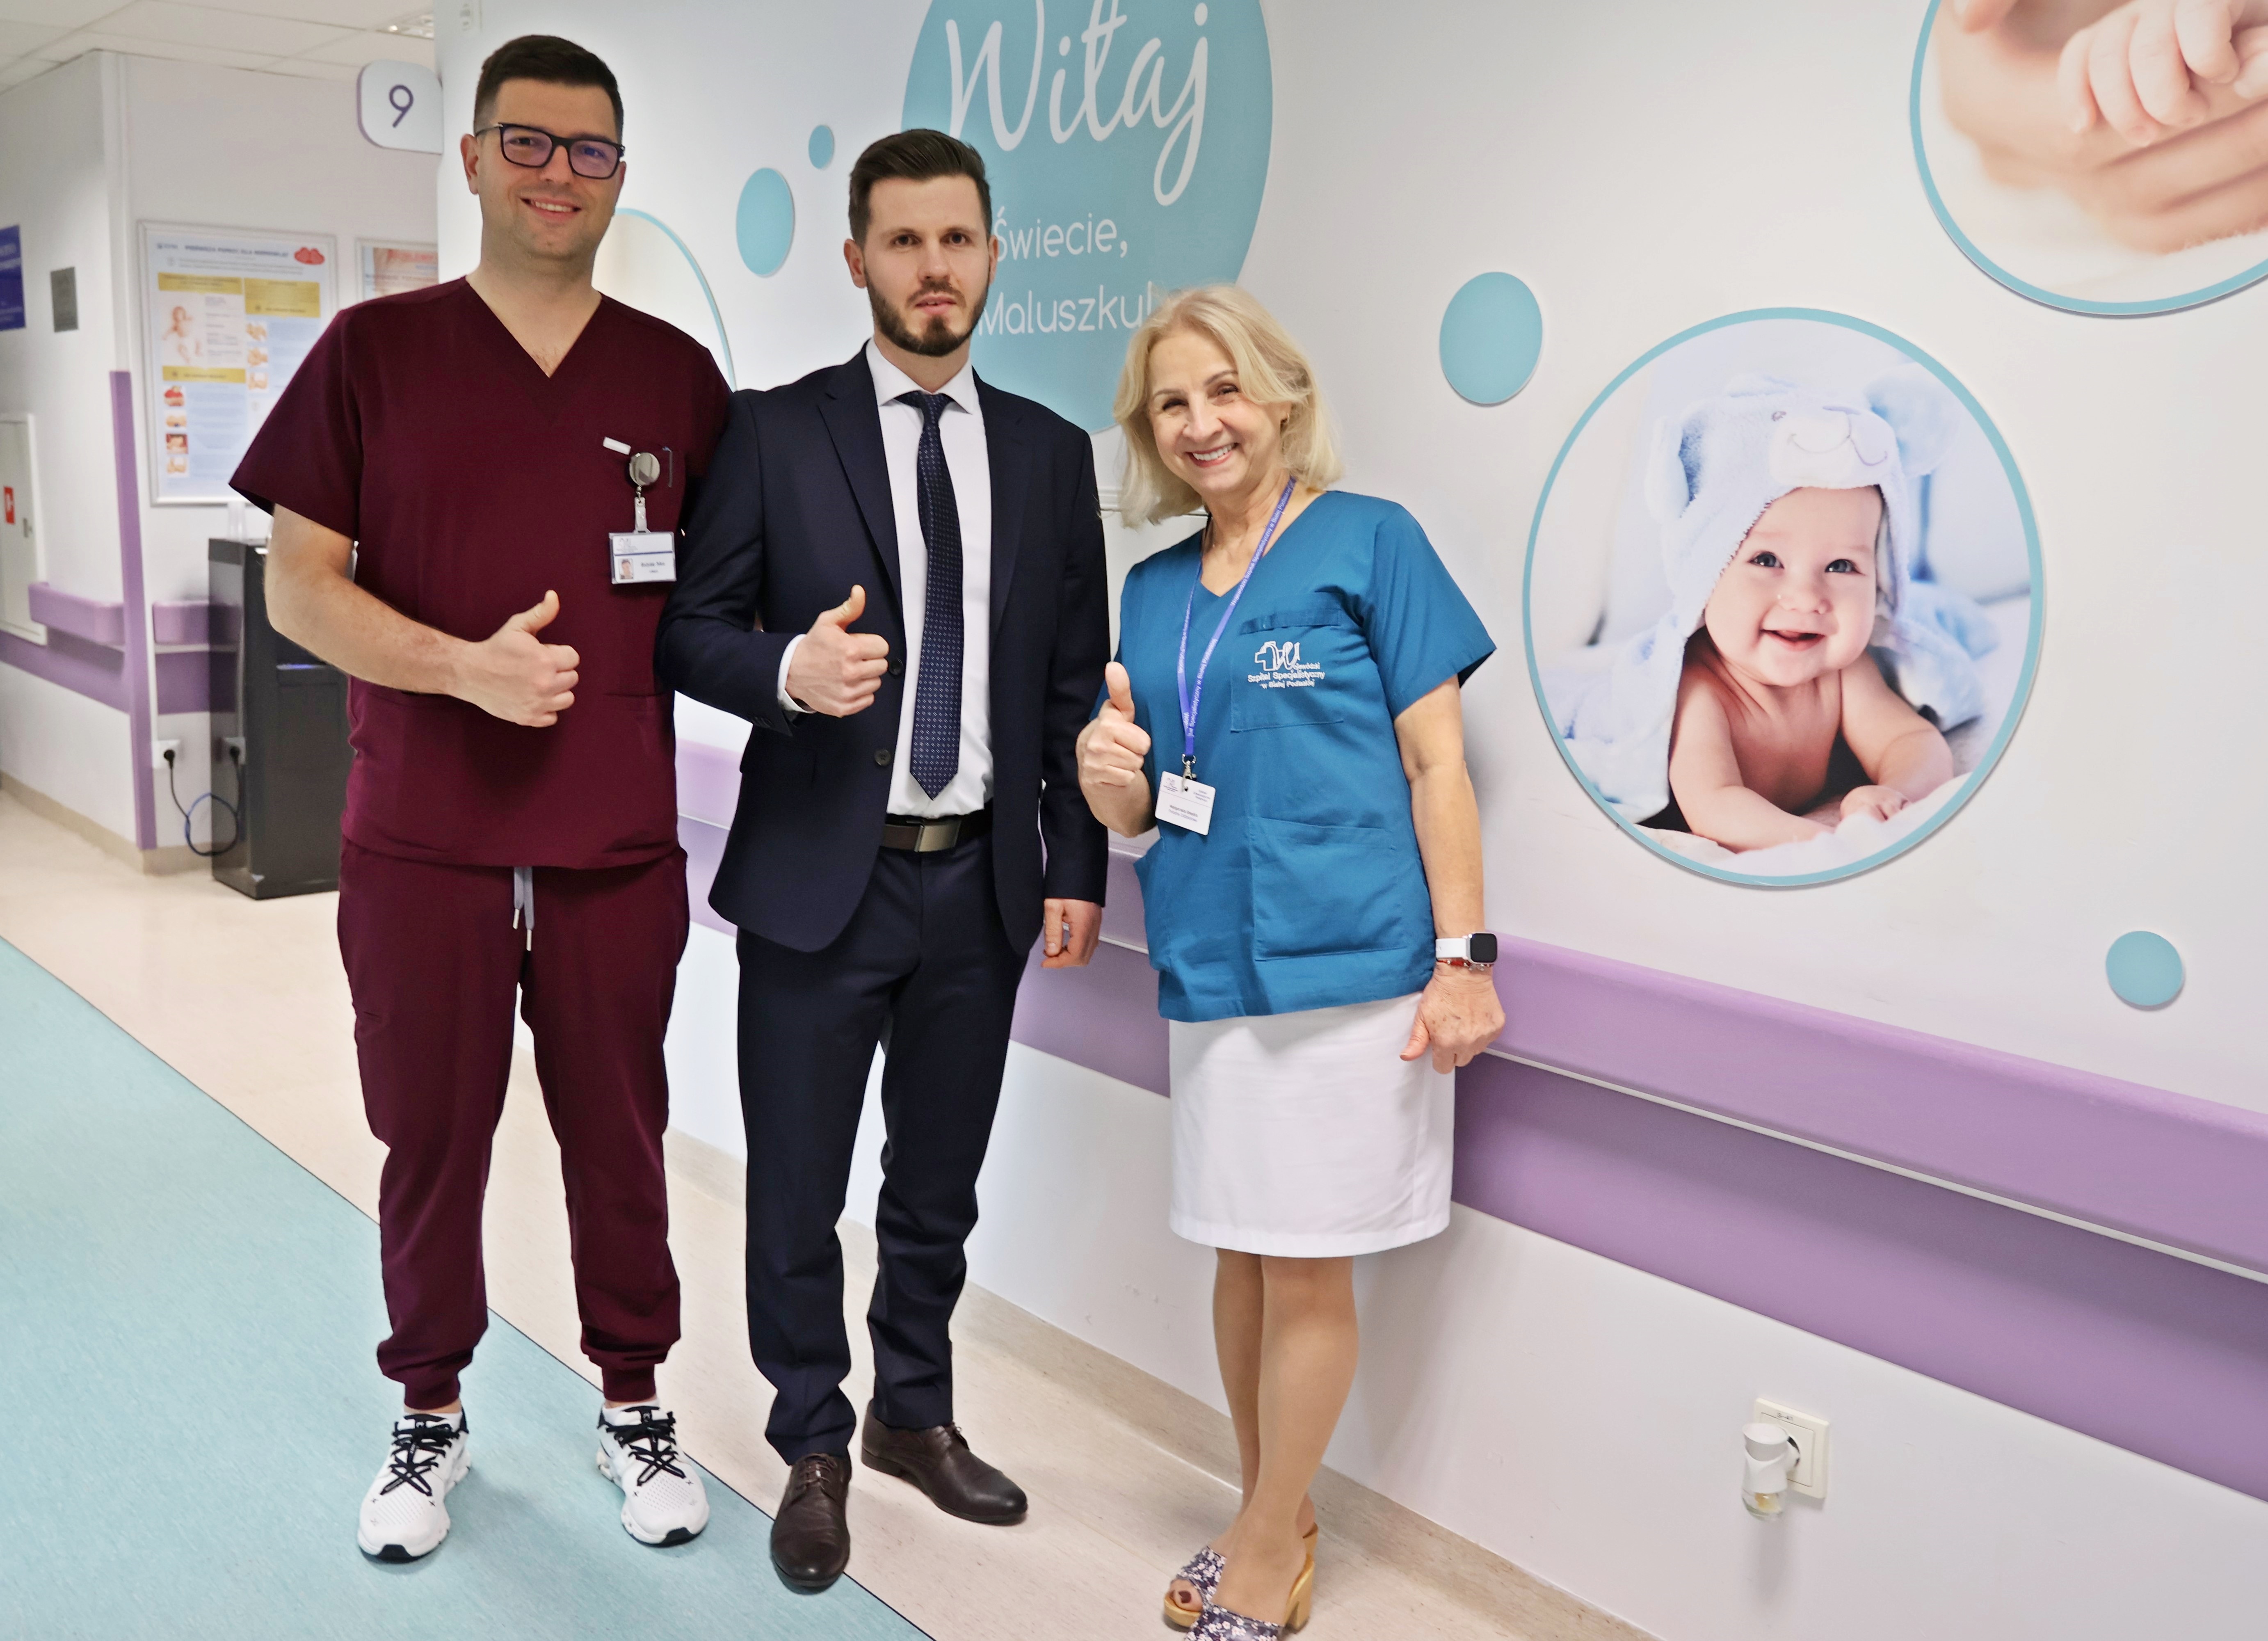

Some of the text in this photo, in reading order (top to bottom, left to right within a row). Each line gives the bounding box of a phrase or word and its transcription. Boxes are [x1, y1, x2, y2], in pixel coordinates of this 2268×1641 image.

[389, 85, 413, 128] 9
[946, 0, 1208, 206] Witaj
[994, 206, 1128, 262] Świecie,
